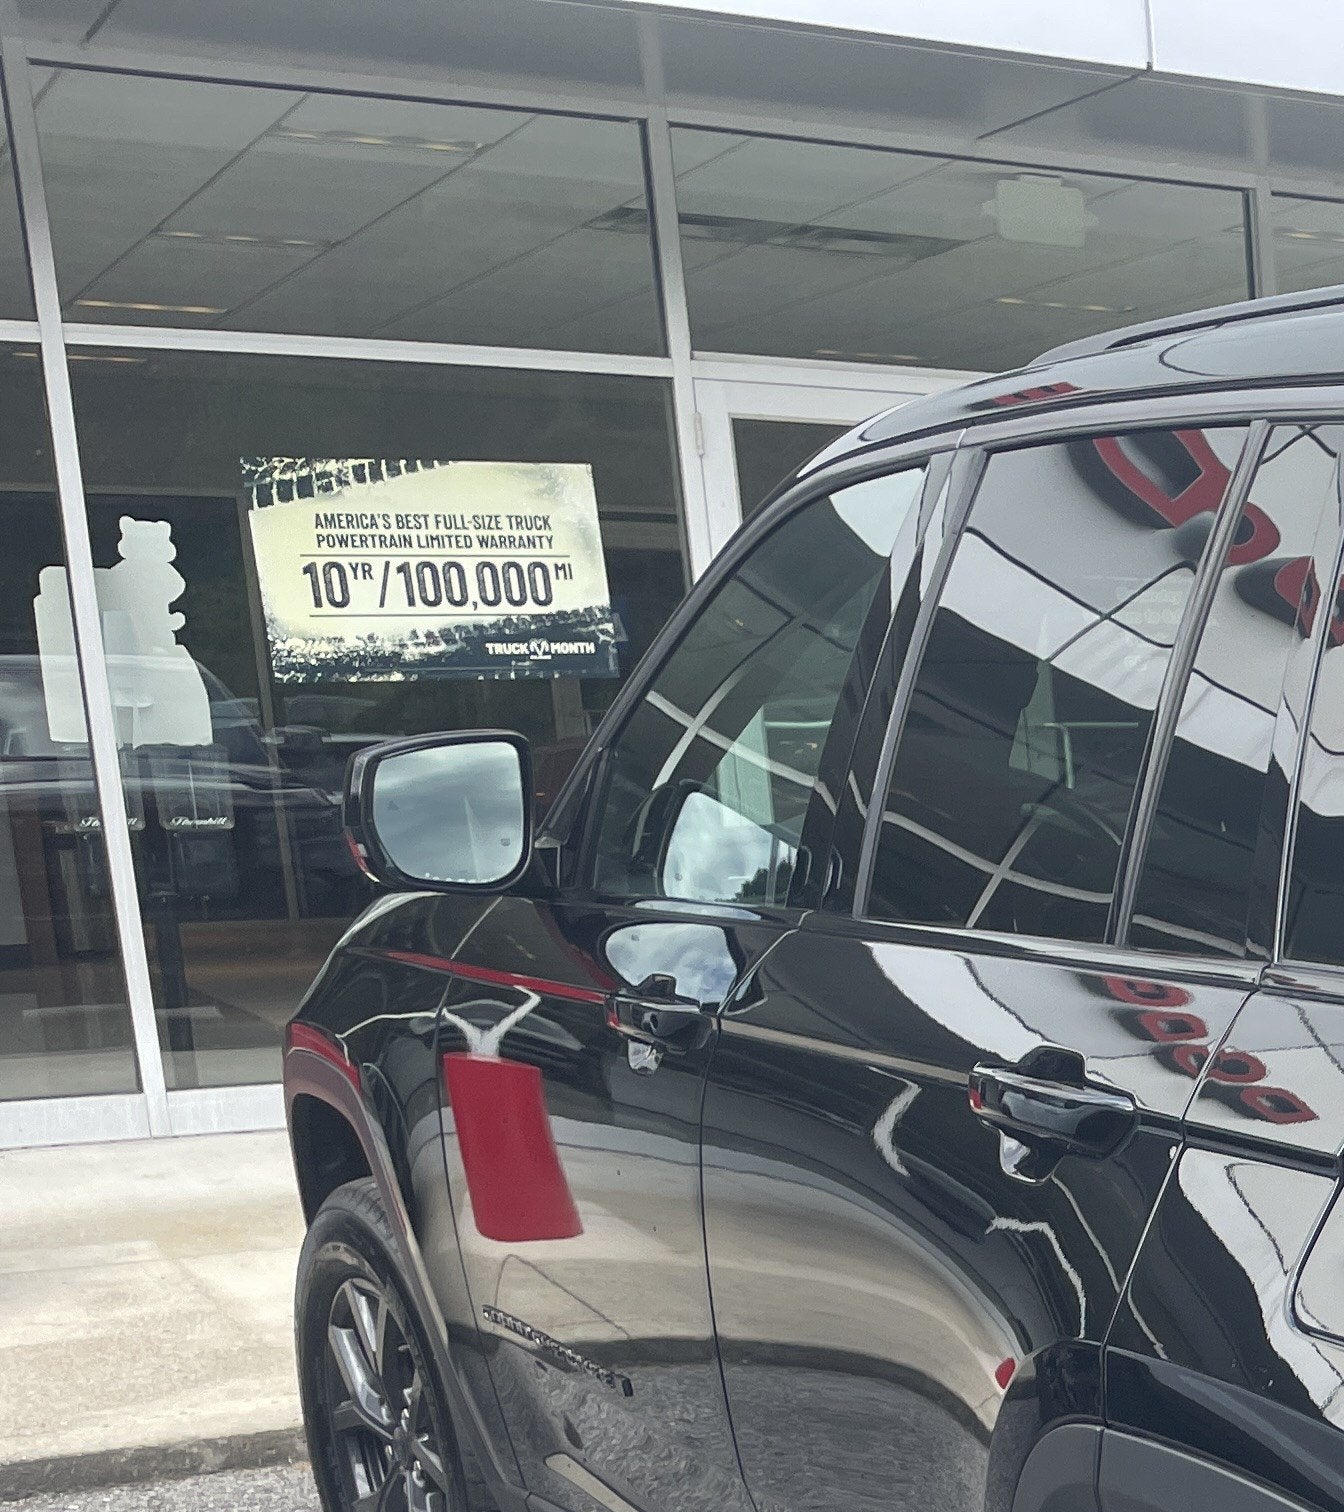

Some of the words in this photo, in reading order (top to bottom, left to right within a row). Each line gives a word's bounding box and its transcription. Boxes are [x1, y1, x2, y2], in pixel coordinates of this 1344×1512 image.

[314, 513, 392, 530] AMERICA'S
[396, 513, 430, 530] BEST
[435, 513, 503, 531] FULL-SIZE
[506, 514, 552, 531] TRUCK
[316, 533, 413, 549] POWERTRAIN
[417, 534, 473, 549] LIMITED
[477, 534, 554, 550] WARRANTY
[485, 642, 530, 655] TRUCK
[550, 641, 595, 655] MONTH
